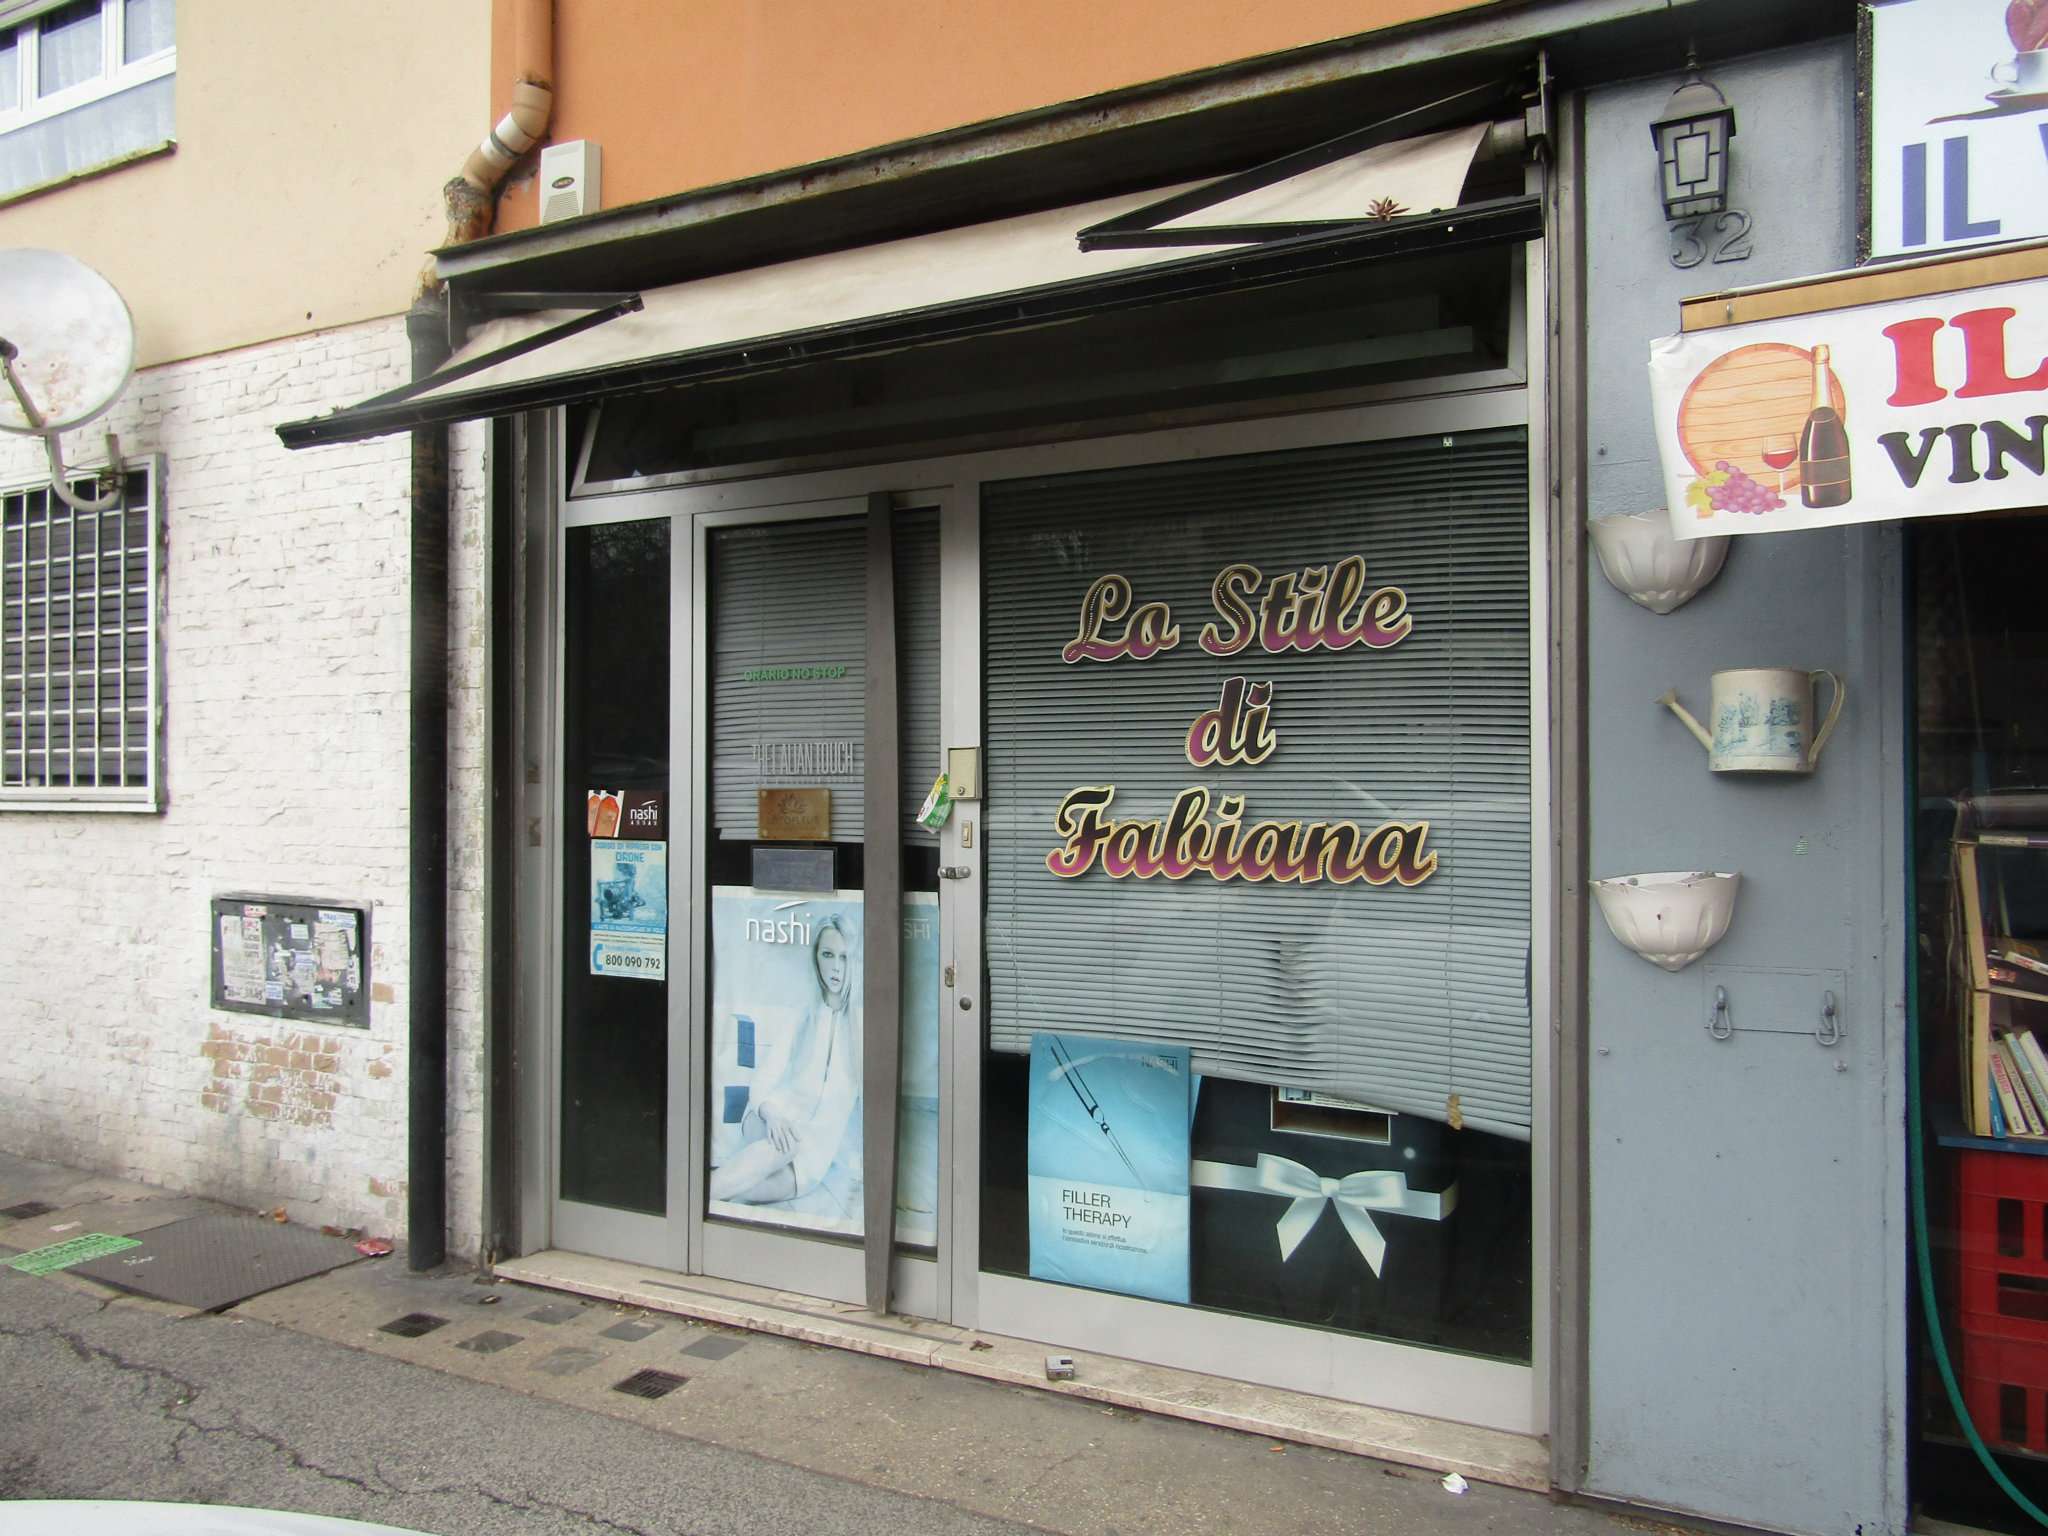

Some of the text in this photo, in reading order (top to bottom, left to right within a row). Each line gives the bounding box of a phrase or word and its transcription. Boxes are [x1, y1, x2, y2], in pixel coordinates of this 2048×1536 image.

[1902, 135, 2001, 247] IL
[1669, 209, 1753, 269] 32
[1882, 307, 2048, 407] IL
[1877, 415, 2048, 488] VIN
[1062, 555, 1412, 664] Lo Stile
[744, 668, 789, 681] ORARIO
[1185, 676, 1276, 766] di
[814, 742, 853, 774] TOUCH
[630, 804, 658, 820] nashi
[1046, 784, 1438, 886] Fabiana
[746, 913, 811, 945] nashi
[605, 954, 661, 969] 800 090 792
[1062, 1189, 1111, 1208] FILLER
[1063, 1206, 1132, 1228] THERAPY
